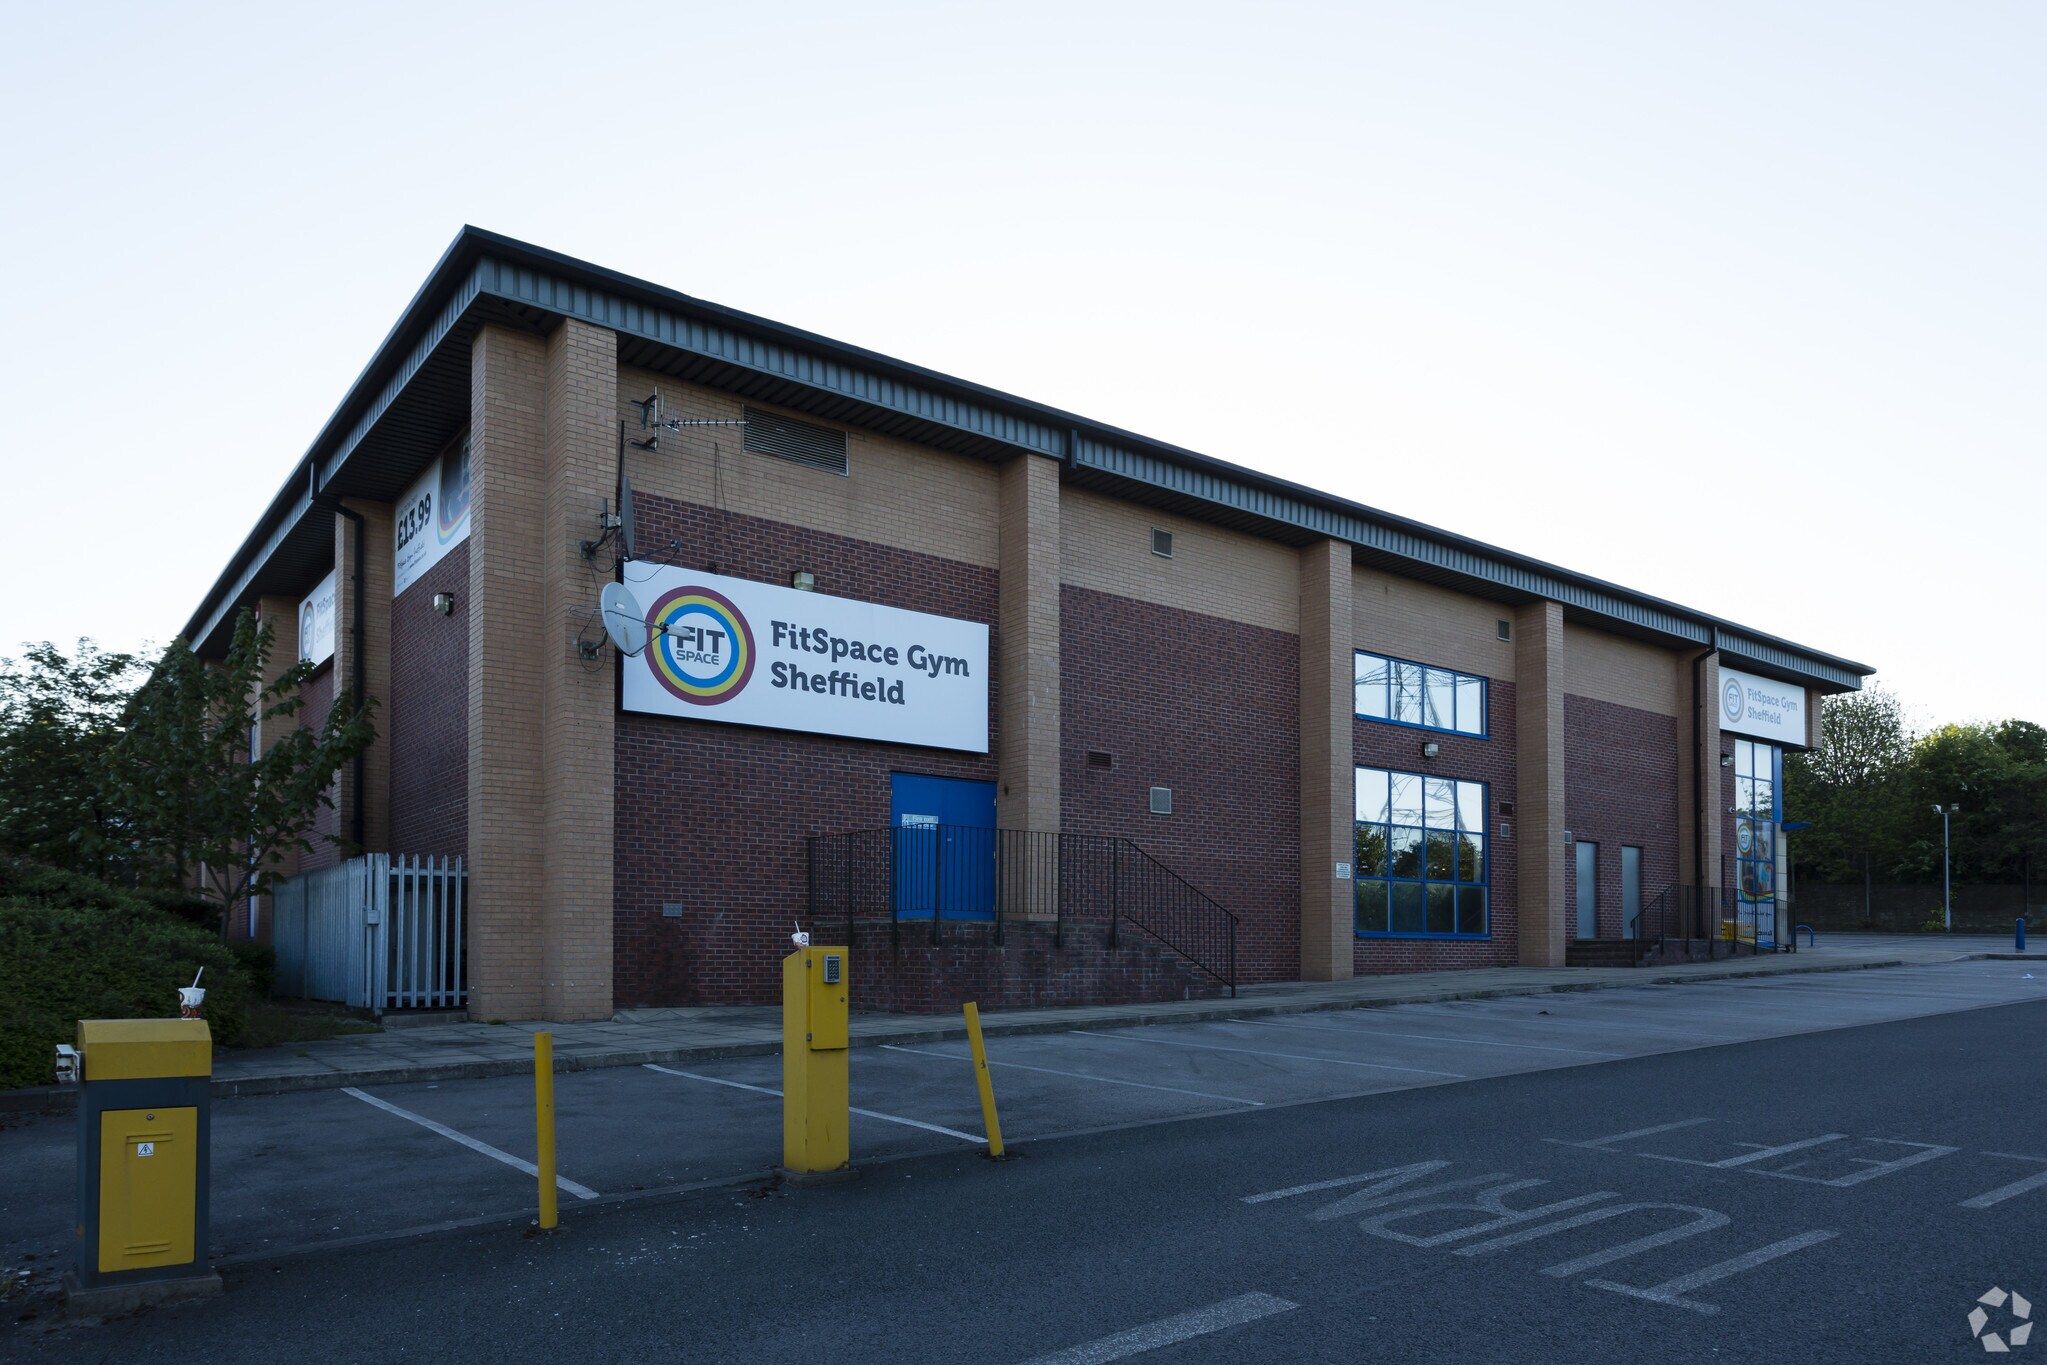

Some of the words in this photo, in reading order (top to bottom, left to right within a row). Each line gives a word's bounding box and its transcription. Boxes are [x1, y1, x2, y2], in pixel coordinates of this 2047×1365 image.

[397, 492, 431, 552] £13.99
[676, 625, 725, 654] FIT
[676, 649, 720, 666] SPACE
[770, 620, 898, 665] FitSpace
[907, 644, 970, 678] Gym
[770, 661, 905, 705] Sheffield
[1747, 688, 1779, 706] FitSpace
[1781, 696, 1798, 712] Gym
[1748, 706, 1781, 725] Sheffield
[1238, 1158, 1841, 1316] TURN
